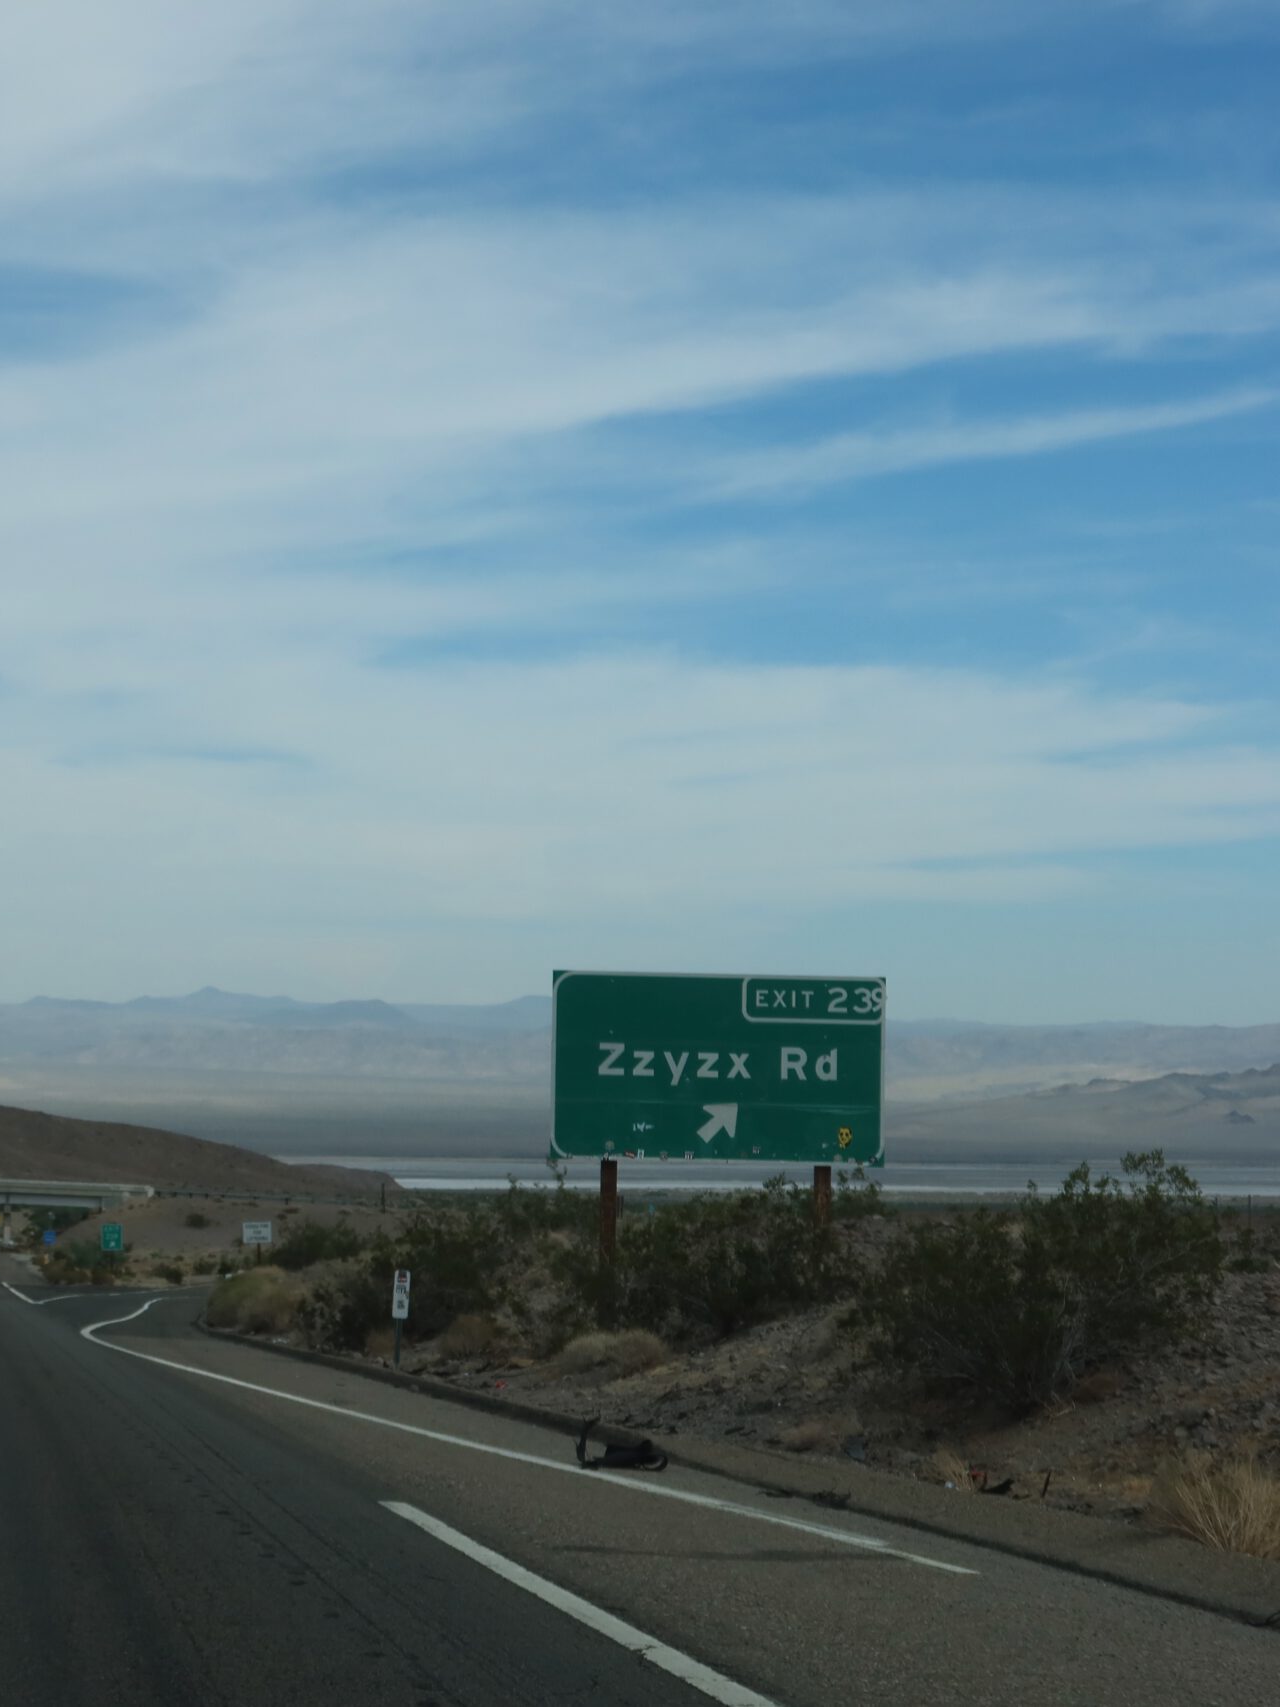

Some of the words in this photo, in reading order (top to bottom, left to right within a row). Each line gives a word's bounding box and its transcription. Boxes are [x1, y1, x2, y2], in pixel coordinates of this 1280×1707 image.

[756, 989, 815, 1008] EXIT
[598, 1042, 752, 1086] Zzyzx
[780, 1046, 838, 1081] Rd
